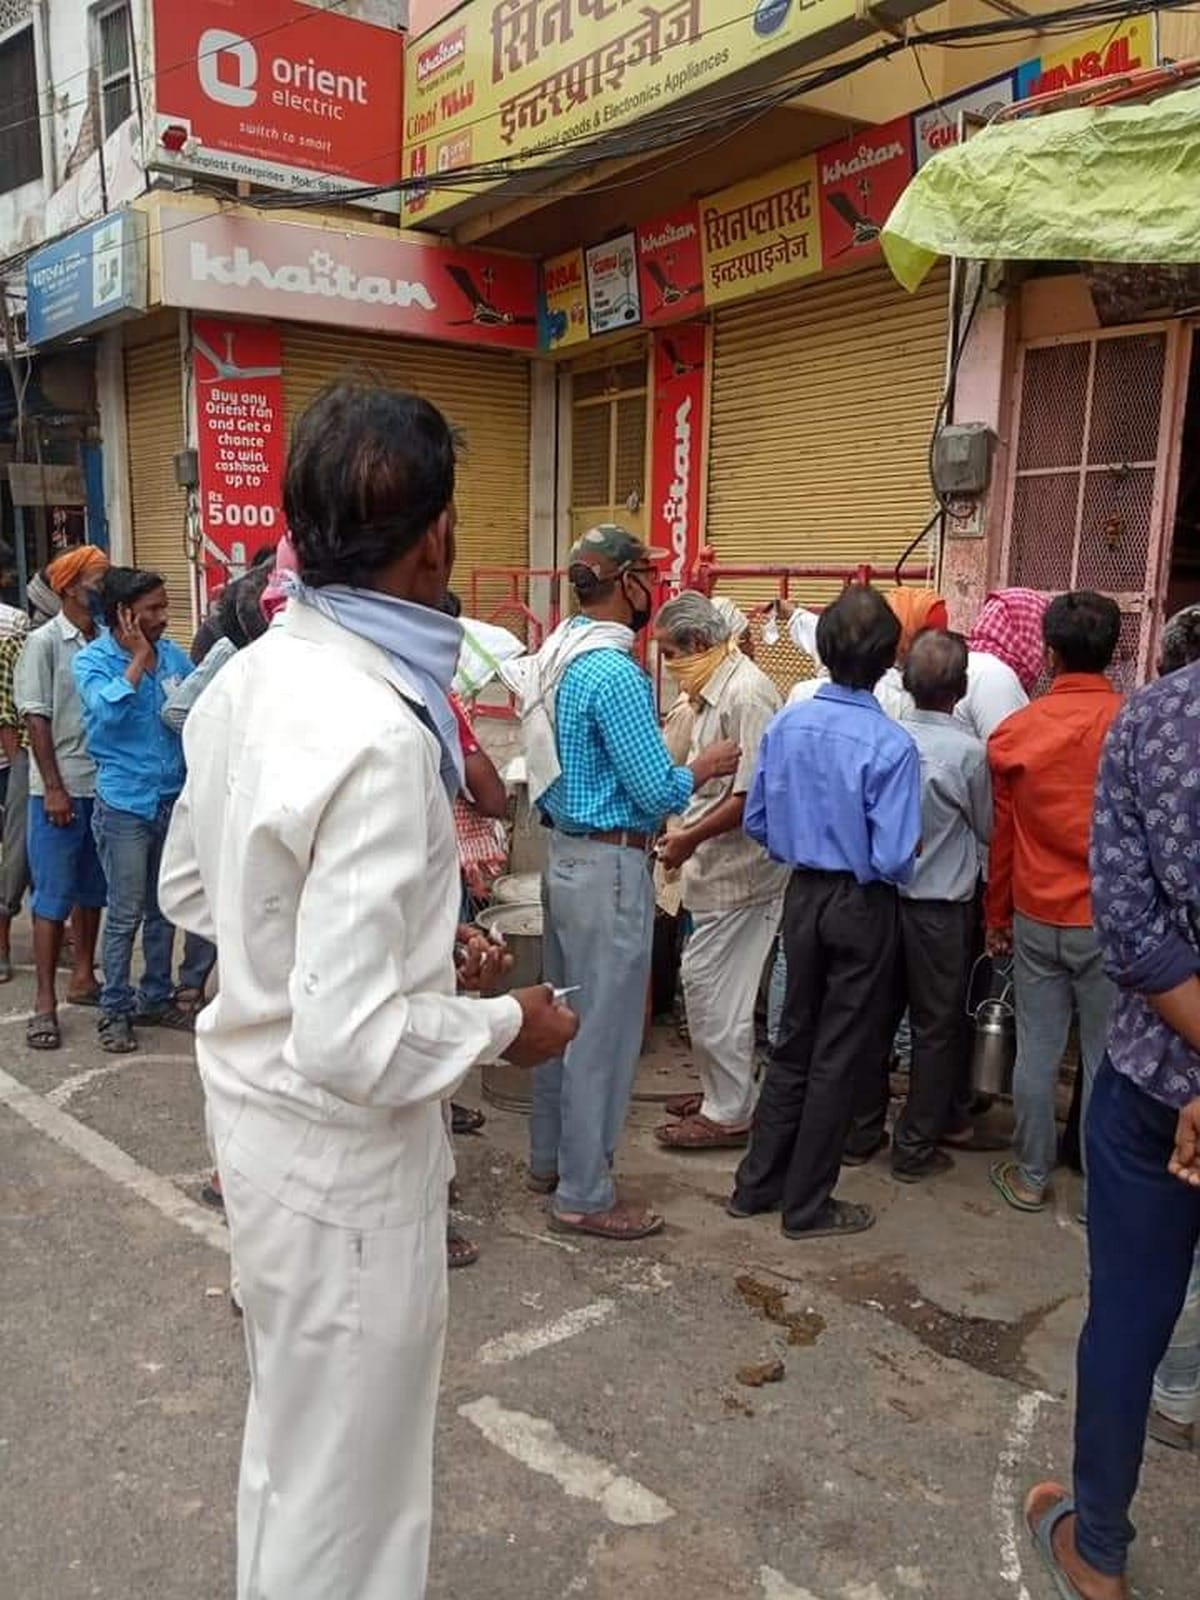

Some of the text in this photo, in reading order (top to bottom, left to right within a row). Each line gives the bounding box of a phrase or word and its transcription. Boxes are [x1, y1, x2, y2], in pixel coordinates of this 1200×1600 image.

[271, 57, 369, 105] orient
[593, 110, 601, 128] &
[603, 83, 662, 122] Electronics
[664, 47, 730, 93] Appliances
[271, 91, 344, 121] electric
[239, 122, 280, 140] switch
[283, 132, 295, 144] to
[822, 139, 905, 185] khaitan
[704, 180, 812, 254] सिनप्लास्ट
[189, 241, 437, 311] khaitan
[205, 401, 248, 416] Orient
[211, 388, 267, 408] Buy any
[208, 418, 272, 433] and Get a
[218, 431, 265, 448] chance
[220, 448, 263, 461] to win
[214, 460, 270, 474] cashback
[225, 474, 261, 488] up to
[208, 503, 276, 528] 5000
